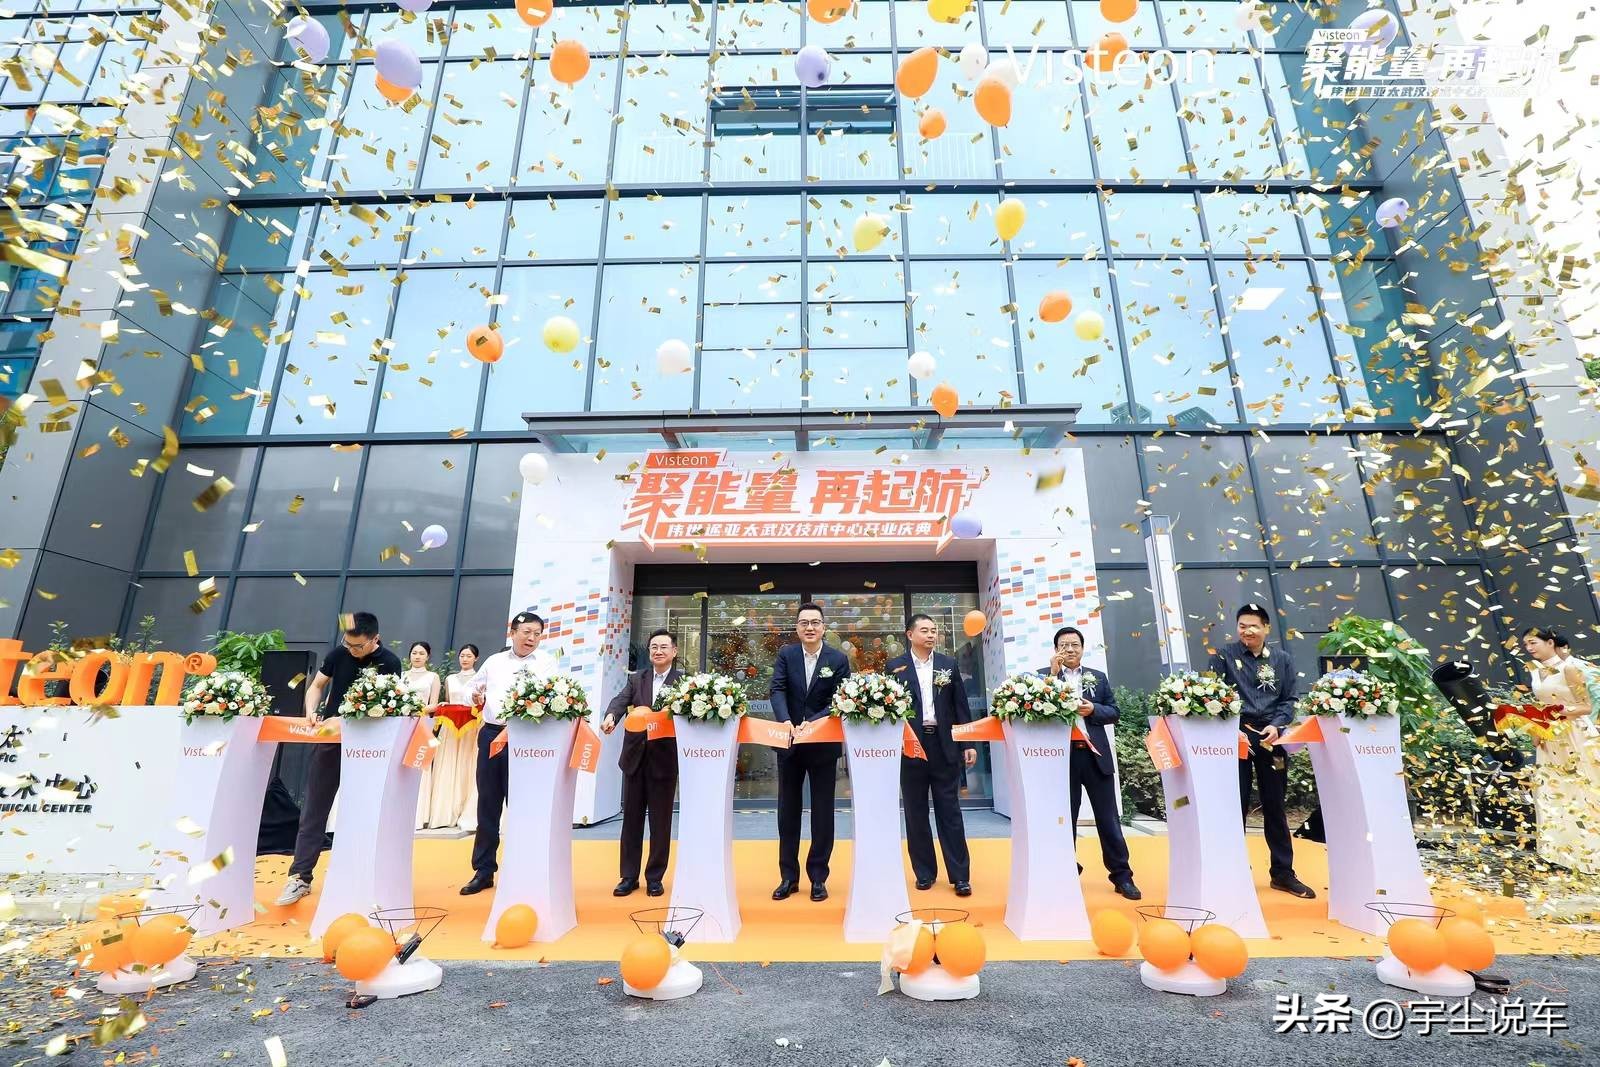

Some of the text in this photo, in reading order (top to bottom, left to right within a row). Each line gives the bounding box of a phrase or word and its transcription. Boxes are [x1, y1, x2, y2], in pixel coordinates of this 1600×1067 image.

[655, 454, 709, 467] Visteon
[623, 468, 968, 520] 聚能量 再起航
[346, 748, 387, 759] Visteon
[513, 747, 555, 758] Visteon
[683, 747, 724, 758] Visteon
[854, 747, 896, 758] Visteon
[1022, 746, 1065, 757] Visteon
[1191, 745, 1234, 756] Visteon
[1354, 744, 1396, 755] Visteon
[42, 803, 92, 813] CENTER
